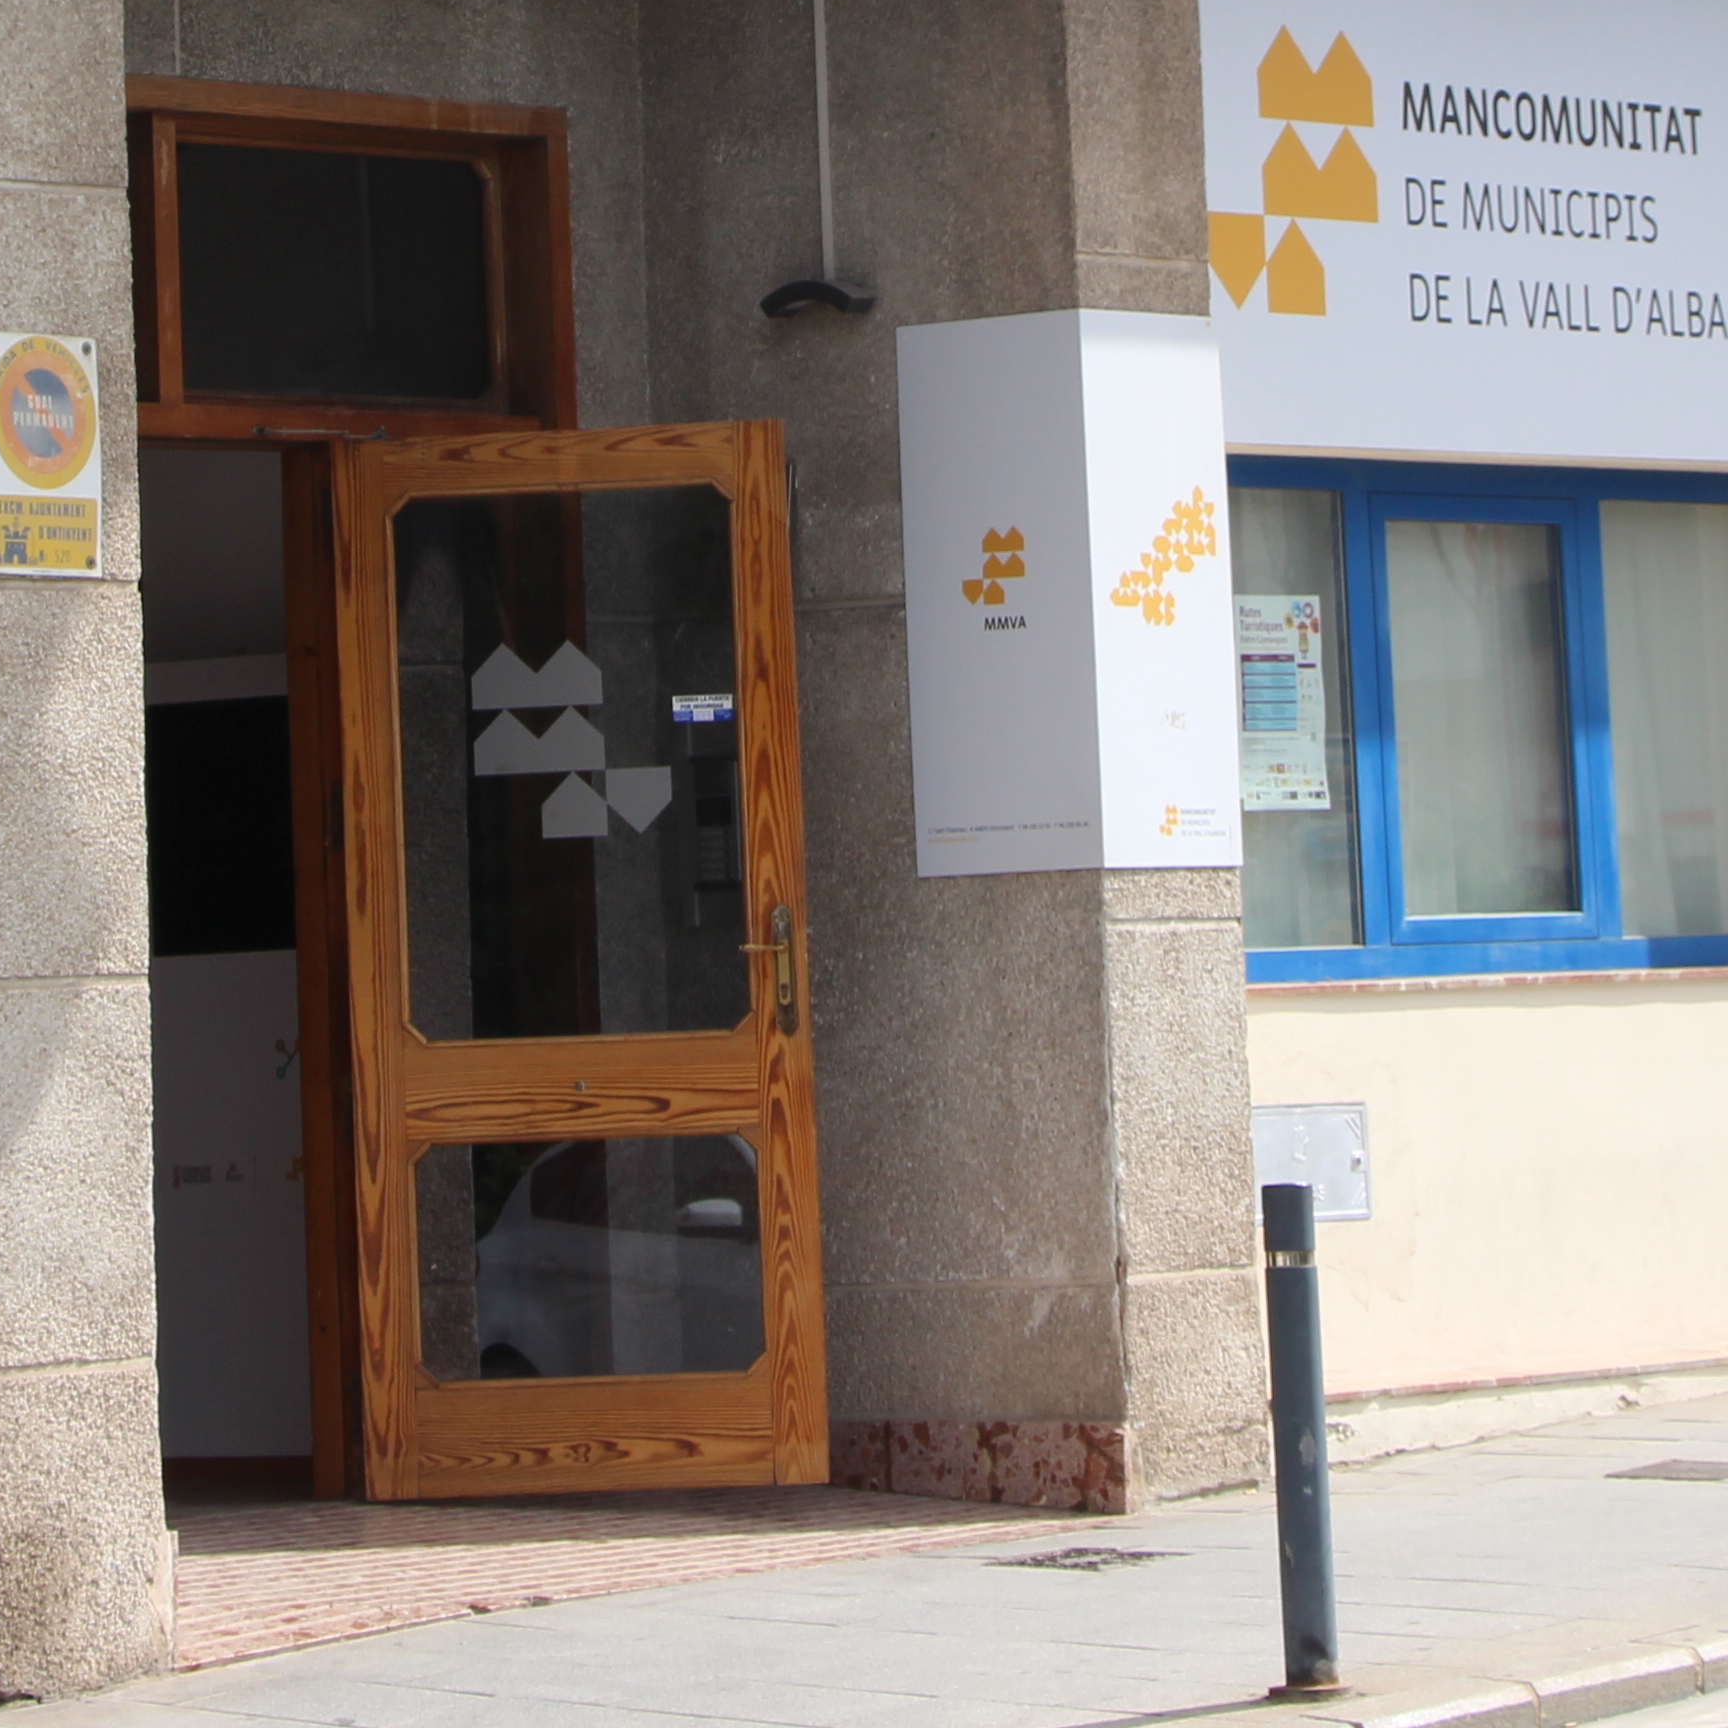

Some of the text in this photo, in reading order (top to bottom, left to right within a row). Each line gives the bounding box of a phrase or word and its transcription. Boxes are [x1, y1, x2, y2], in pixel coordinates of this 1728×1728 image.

[1401, 80, 1702, 156] MANCOMUNITAT
[1404, 176, 1660, 243] DE MUNICIPIS
[1408, 273, 1453, 324] DE
[1465, 276, 1508, 328] LA
[1518, 279, 1601, 333] VALL
[21, 339, 35, 353] DE
[13, 411, 74, 429] PERMANENT
[29, 501, 86, 518] AJUNTAMENT
[1239, 605, 1261, 618] Rutes
[984, 615, 1027, 631] MMVA
